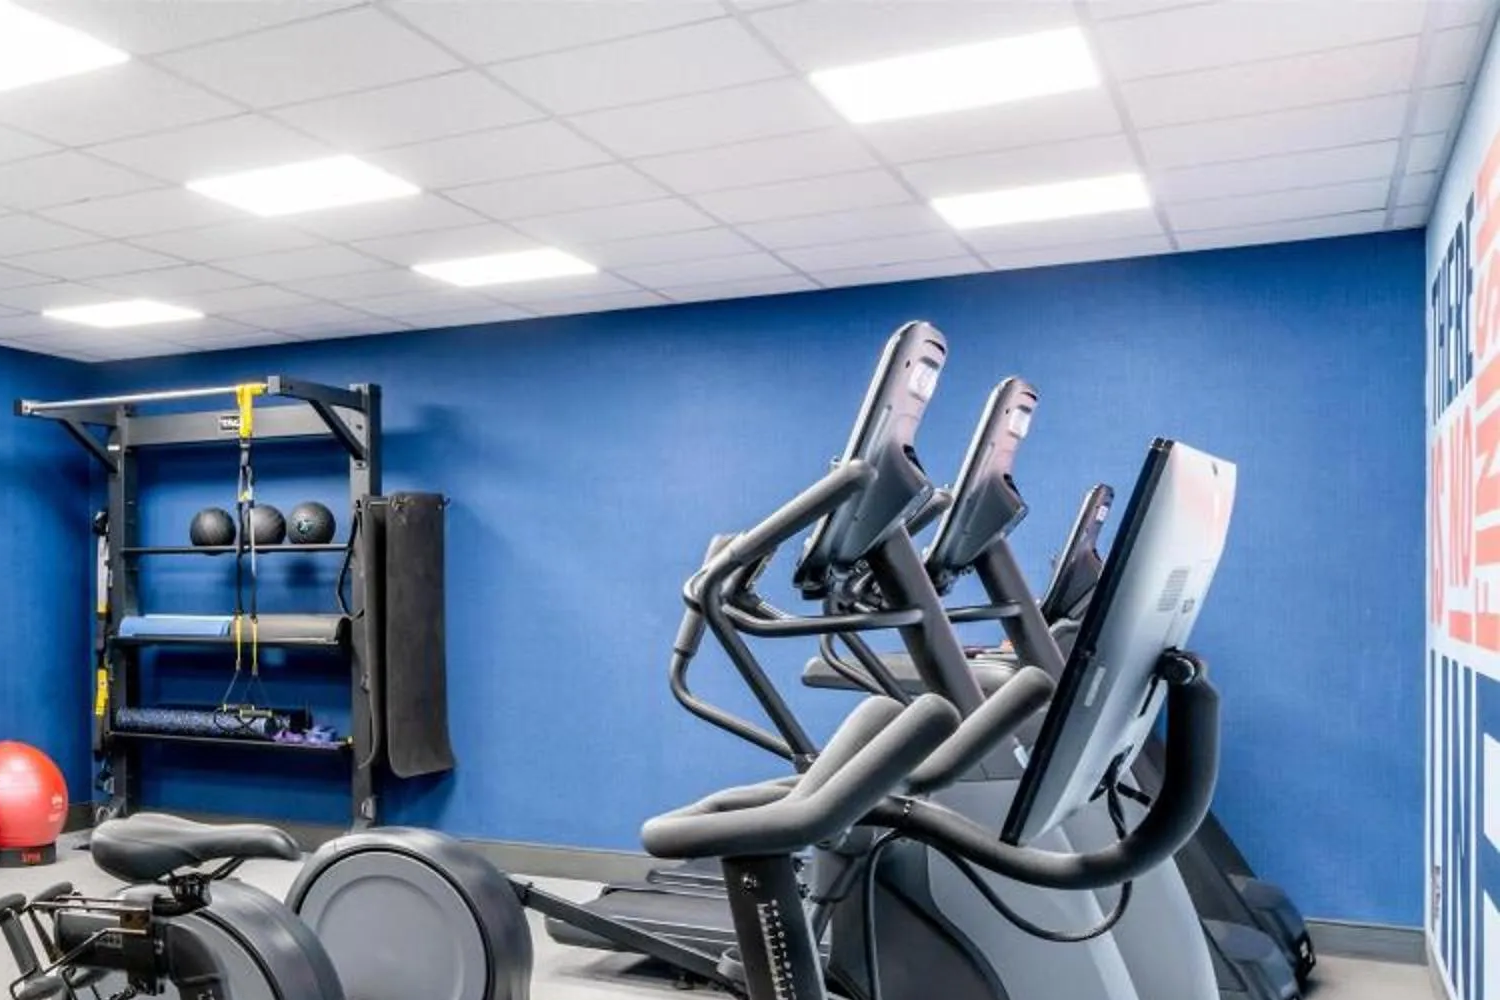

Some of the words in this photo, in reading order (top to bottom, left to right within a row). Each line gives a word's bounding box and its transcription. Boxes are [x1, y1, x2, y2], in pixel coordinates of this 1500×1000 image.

[1431, 190, 1475, 426] THERE
[1430, 435, 1445, 624] IS
[1449, 405, 1474, 588] NO
